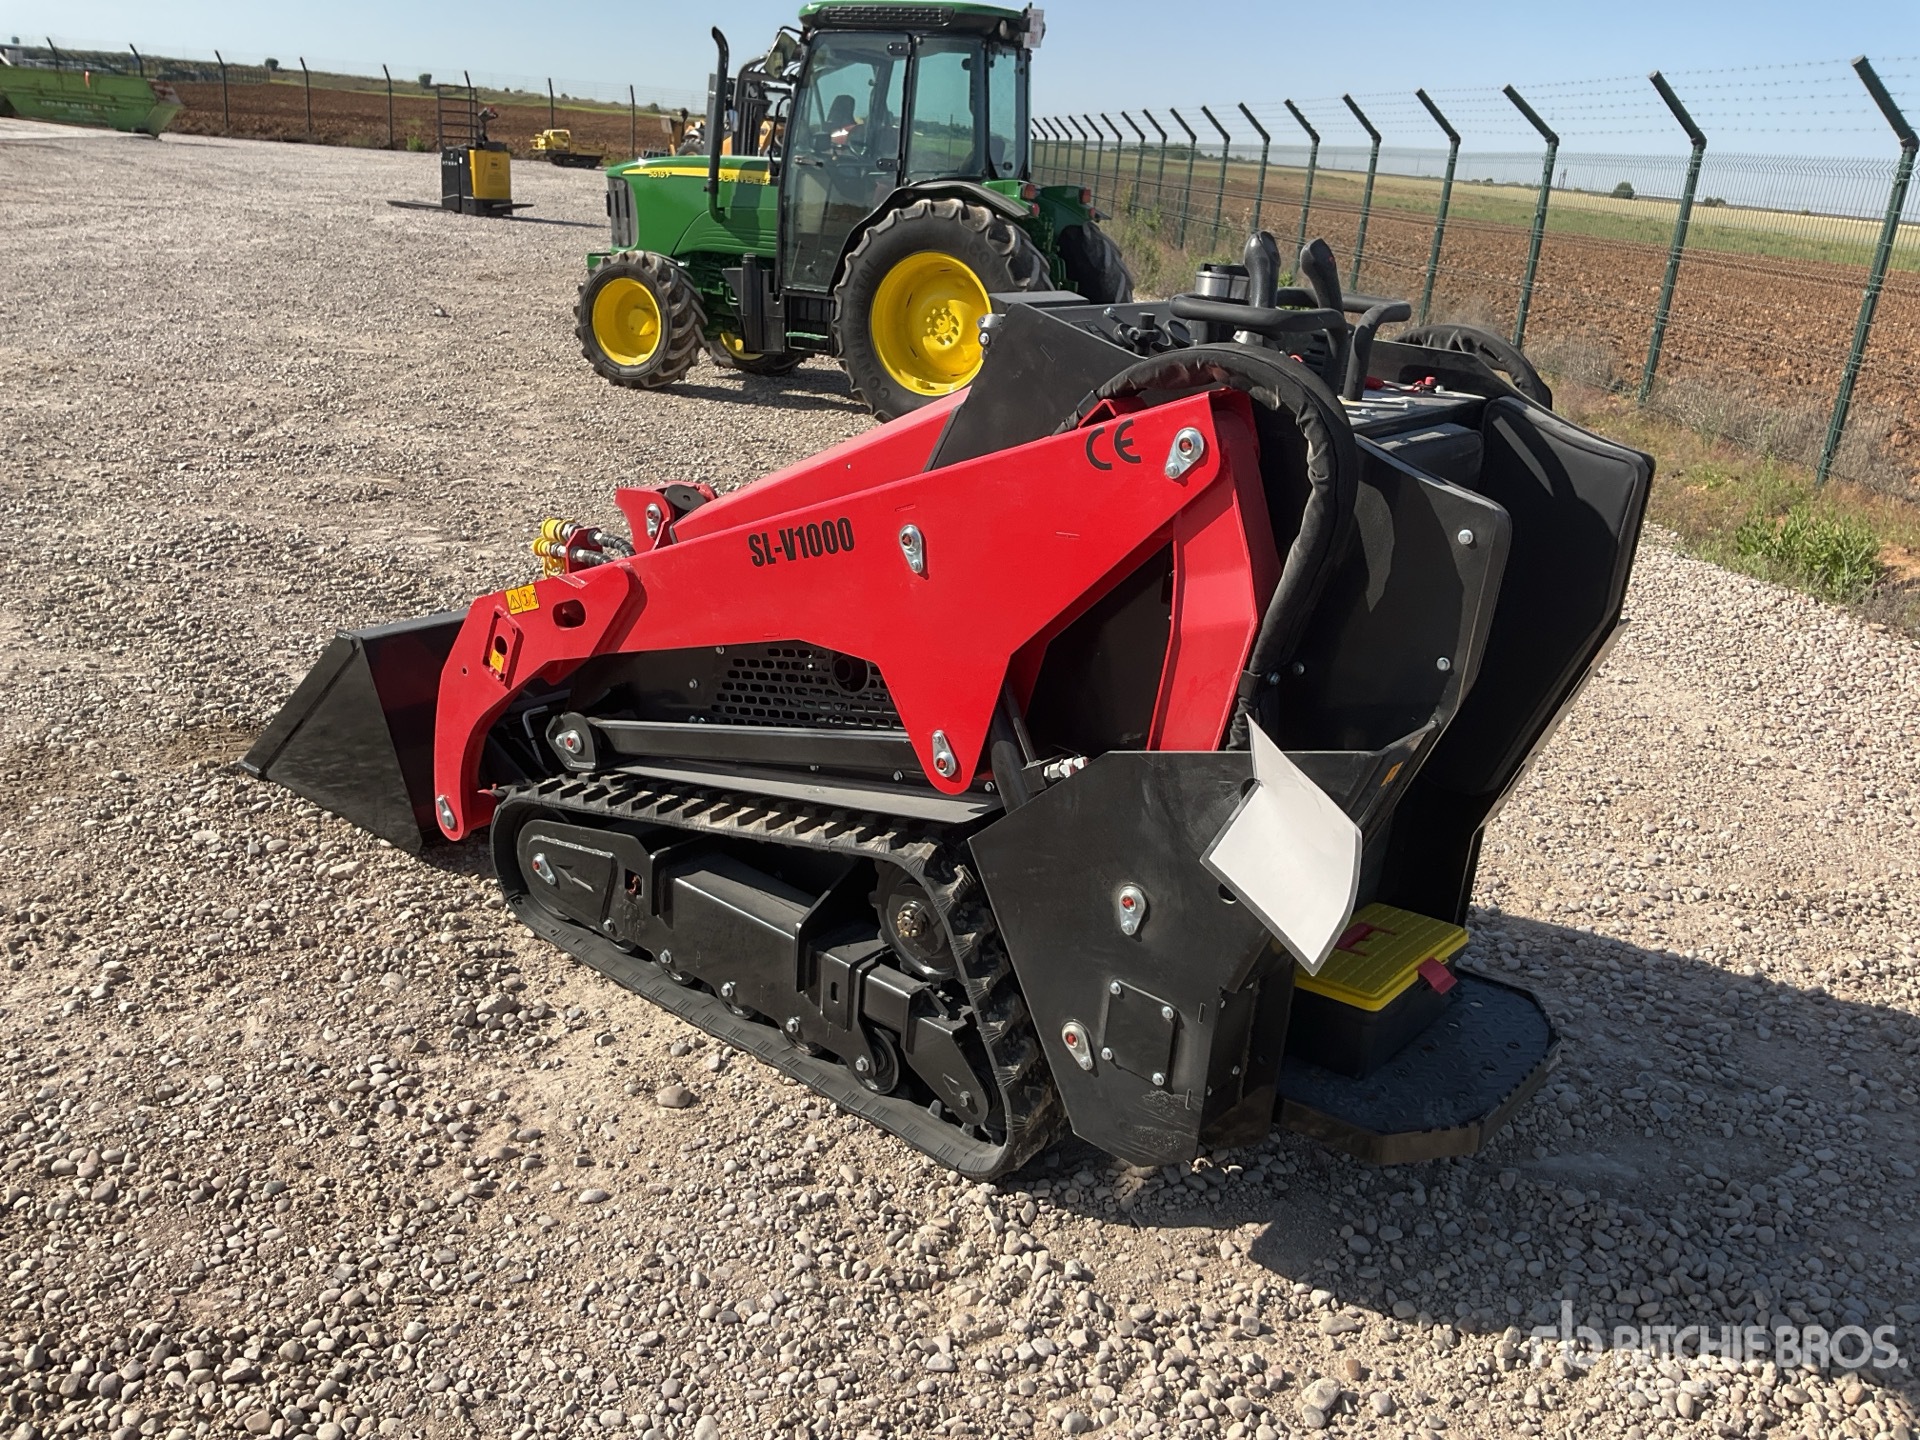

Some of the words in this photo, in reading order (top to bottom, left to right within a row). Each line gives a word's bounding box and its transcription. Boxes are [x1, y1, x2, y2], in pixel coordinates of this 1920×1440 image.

[746, 175, 770, 185] DEER
[1086, 418, 1142, 471] CE
[748, 517, 855, 567] SL-V1000
